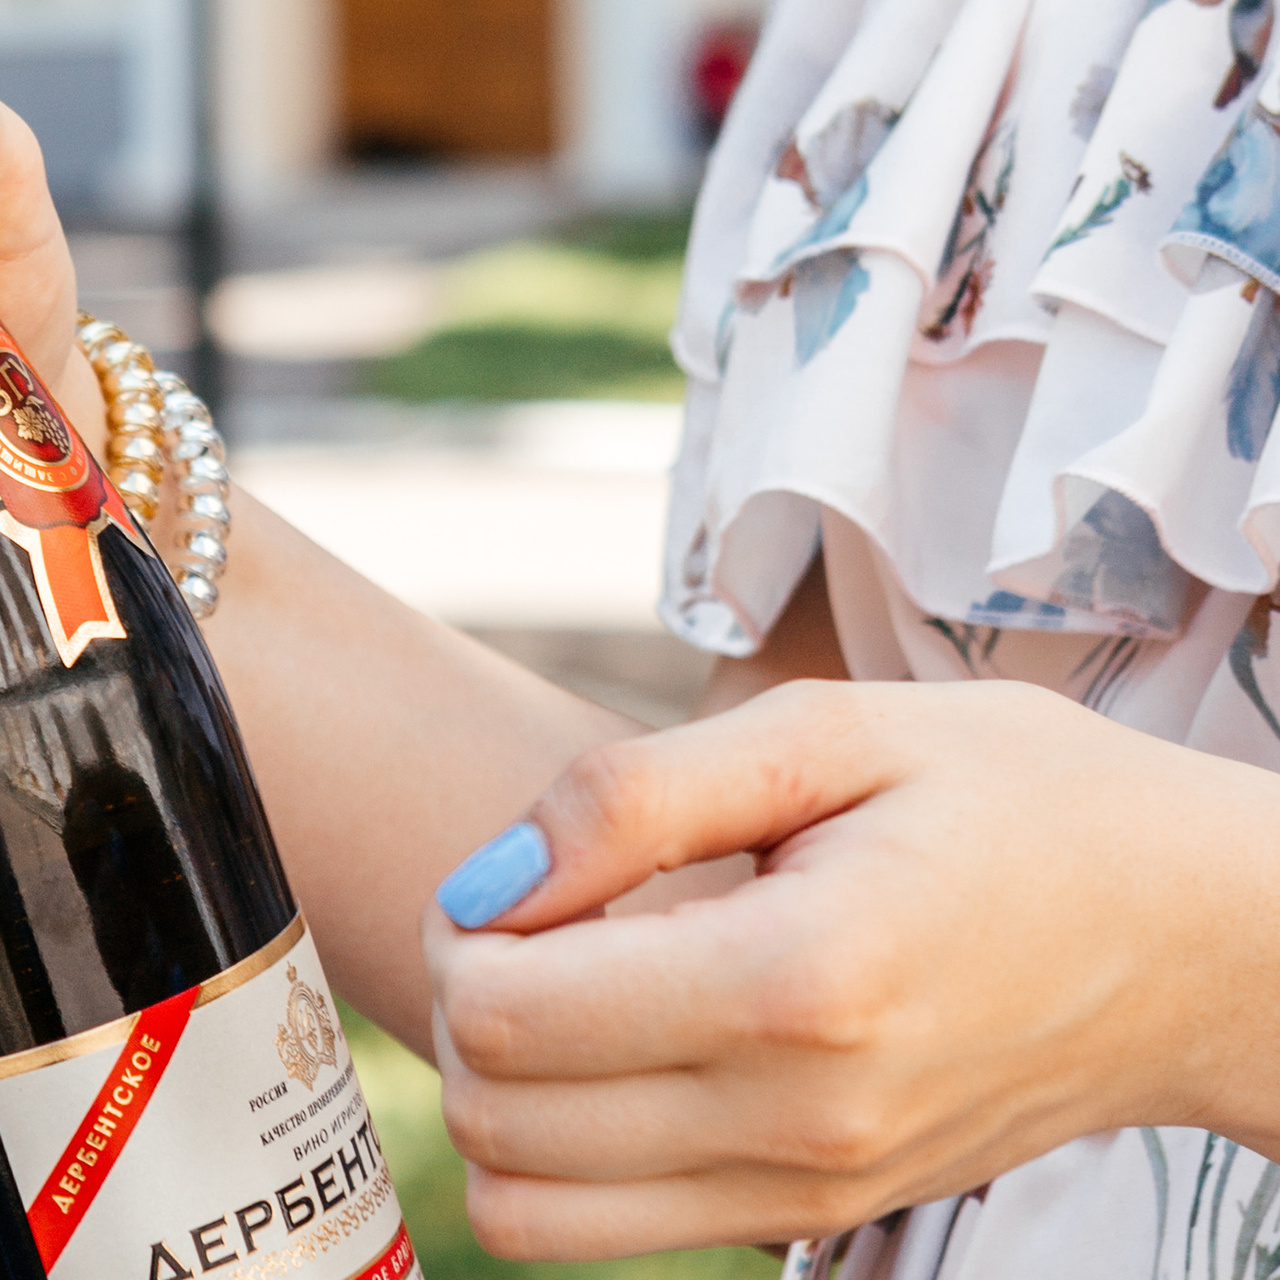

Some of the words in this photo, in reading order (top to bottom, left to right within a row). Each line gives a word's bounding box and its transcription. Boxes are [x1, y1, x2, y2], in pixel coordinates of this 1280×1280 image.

[248, 1081, 289, 1113] РОССИЯ
[51, 1033, 162, 1215] ДЕРБЕНТСКОЕ
[259, 1109, 308, 1147] КАЧЕСТВО
[293, 1128, 329, 1162] ВИНО
